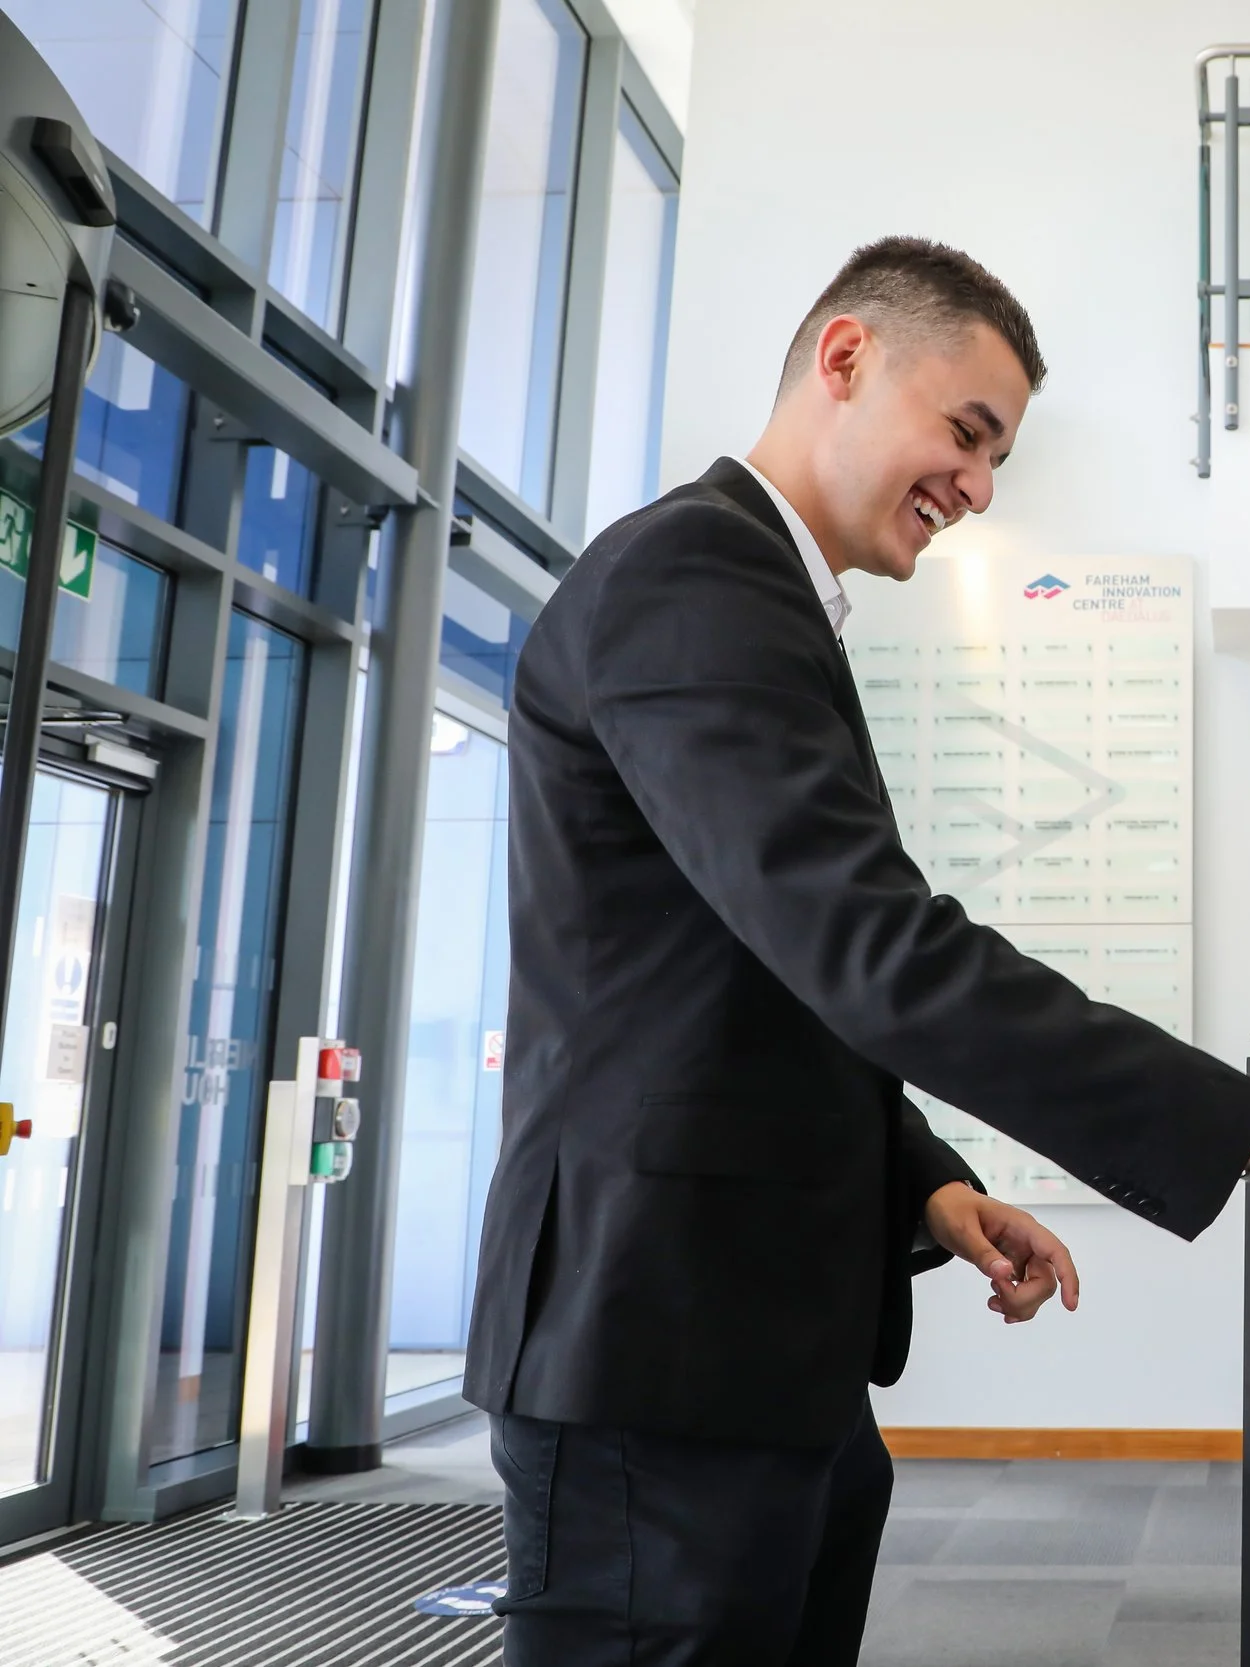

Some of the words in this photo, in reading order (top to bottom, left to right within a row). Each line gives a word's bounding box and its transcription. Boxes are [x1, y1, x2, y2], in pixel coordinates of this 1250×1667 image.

[1085, 574, 1150, 586] FAREHAM
[1102, 586, 1182, 598] INNOVATION
[1073, 599, 1125, 610] CENTRE
